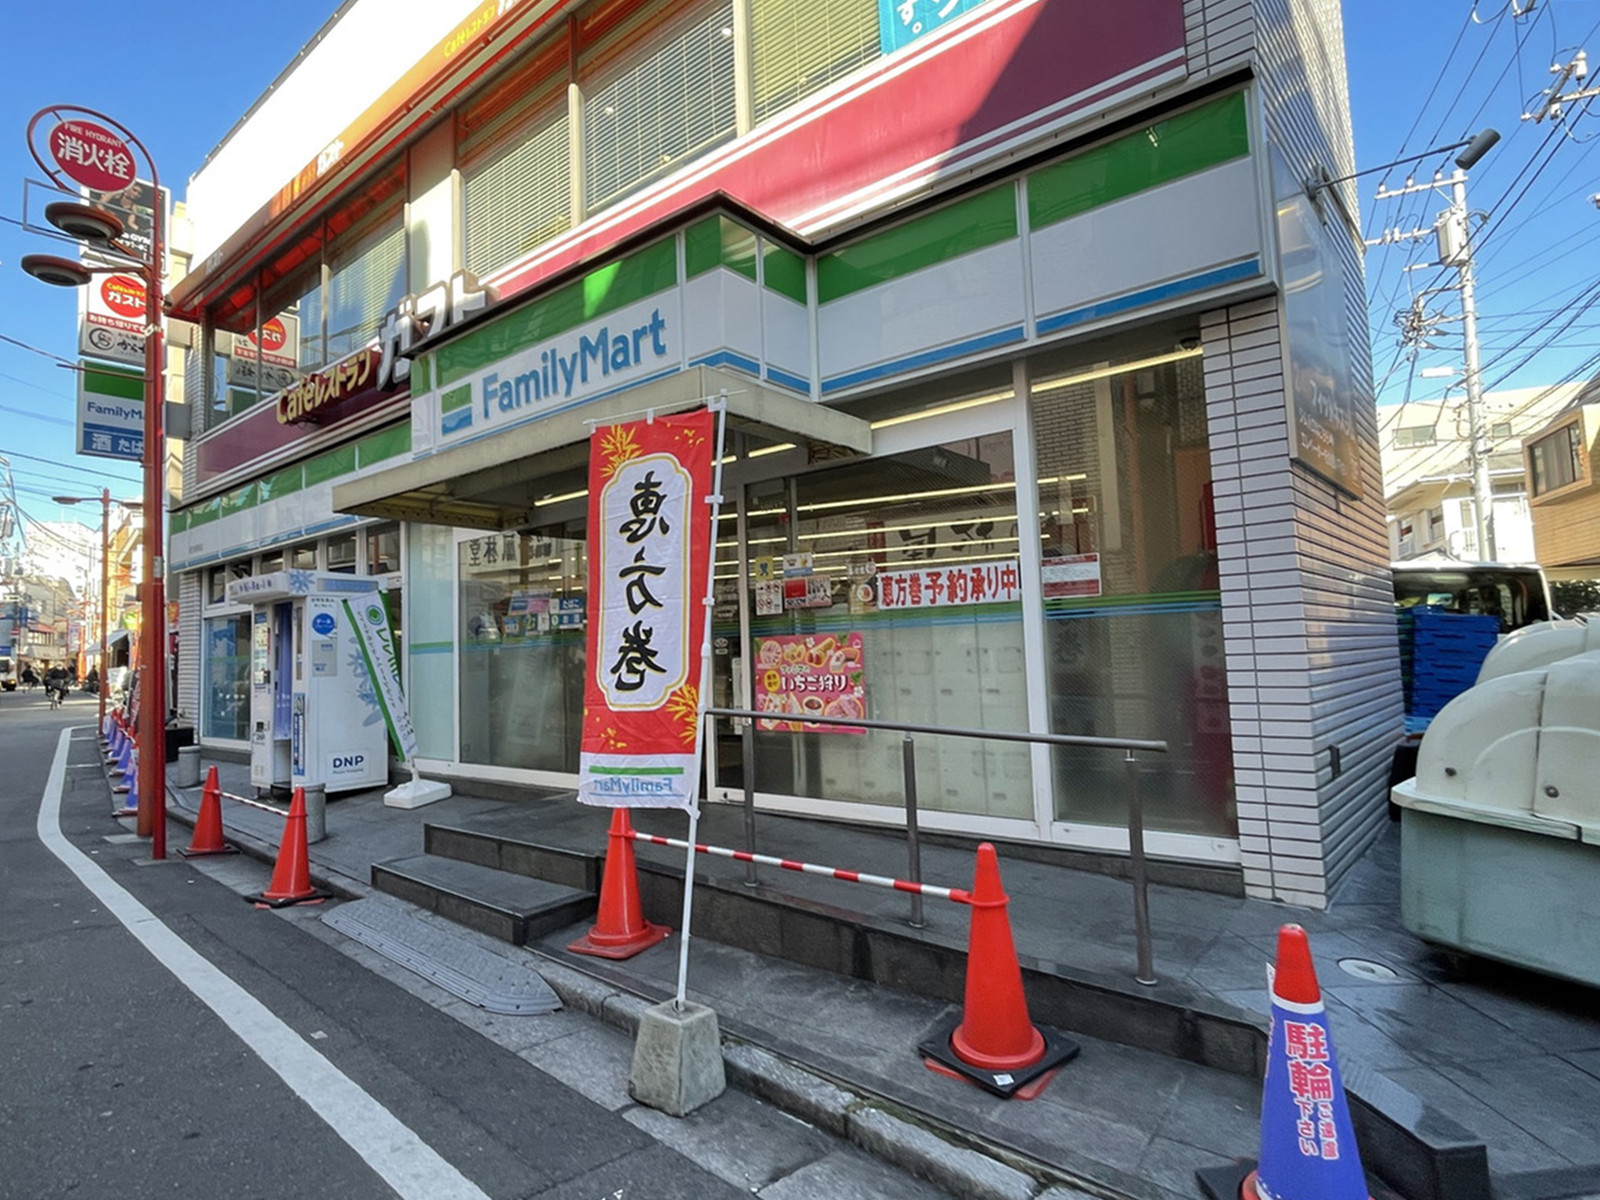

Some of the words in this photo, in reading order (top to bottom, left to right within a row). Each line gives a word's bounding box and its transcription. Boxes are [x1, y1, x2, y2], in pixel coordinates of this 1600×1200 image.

[64, 122, 83, 136] FIRE
[85, 128, 122, 148] HYDRANT
[58, 131, 130, 180] 消火栓
[108, 291, 146, 309] ガスト
[482, 308, 668, 420] FamilyMart
[87, 401, 144, 420] FamilyM
[92, 432, 113, 452] 酒
[880, 563, 1018, 608] 恵方巻予約承り中
[781, 674, 848, 692] いちご狩り
[332, 755, 364, 769] DNP
[1284, 1020, 1334, 1102] 駐輪
